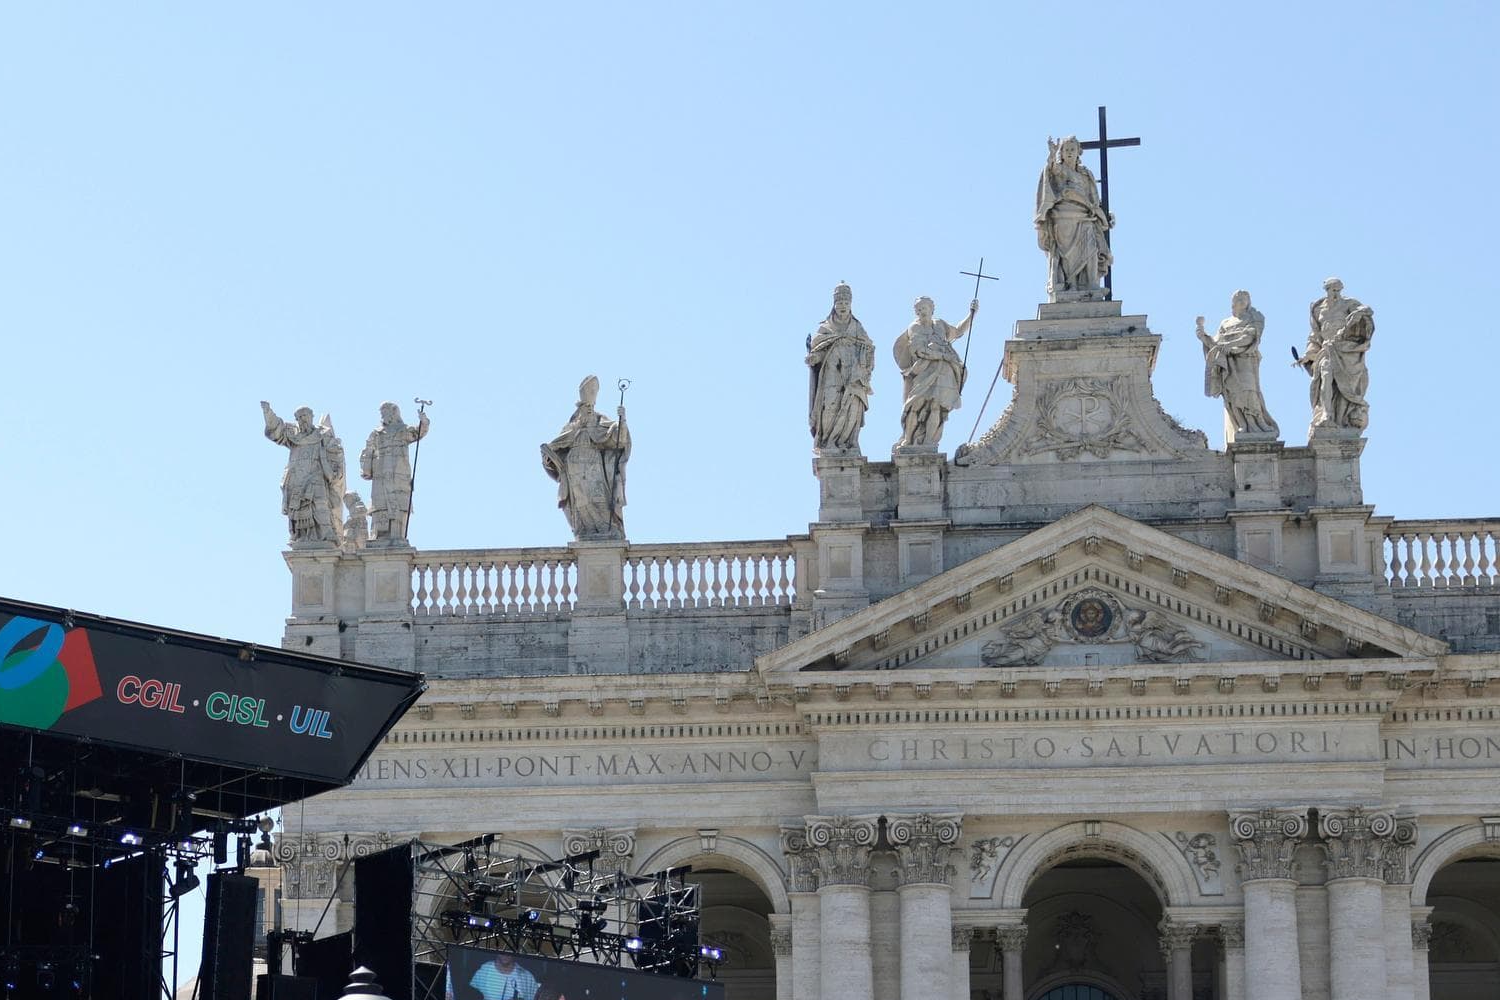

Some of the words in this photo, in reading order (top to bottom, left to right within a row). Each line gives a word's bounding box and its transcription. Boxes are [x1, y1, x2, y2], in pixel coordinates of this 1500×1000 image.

[117, 675, 185, 713] CGIL
[205, 691, 269, 728] CISL
[289, 705, 332, 739] UIL
[867, 735, 1056, 763] CHRISTO
[1080, 731, 1332, 759] SALVATORI
[1383, 738, 1416, 760] IN
[442, 757, 480, 779] XII
[496, 755, 581, 778] PONT
[596, 754, 665, 776] MAX
[680, 751, 772, 774] ANNO
